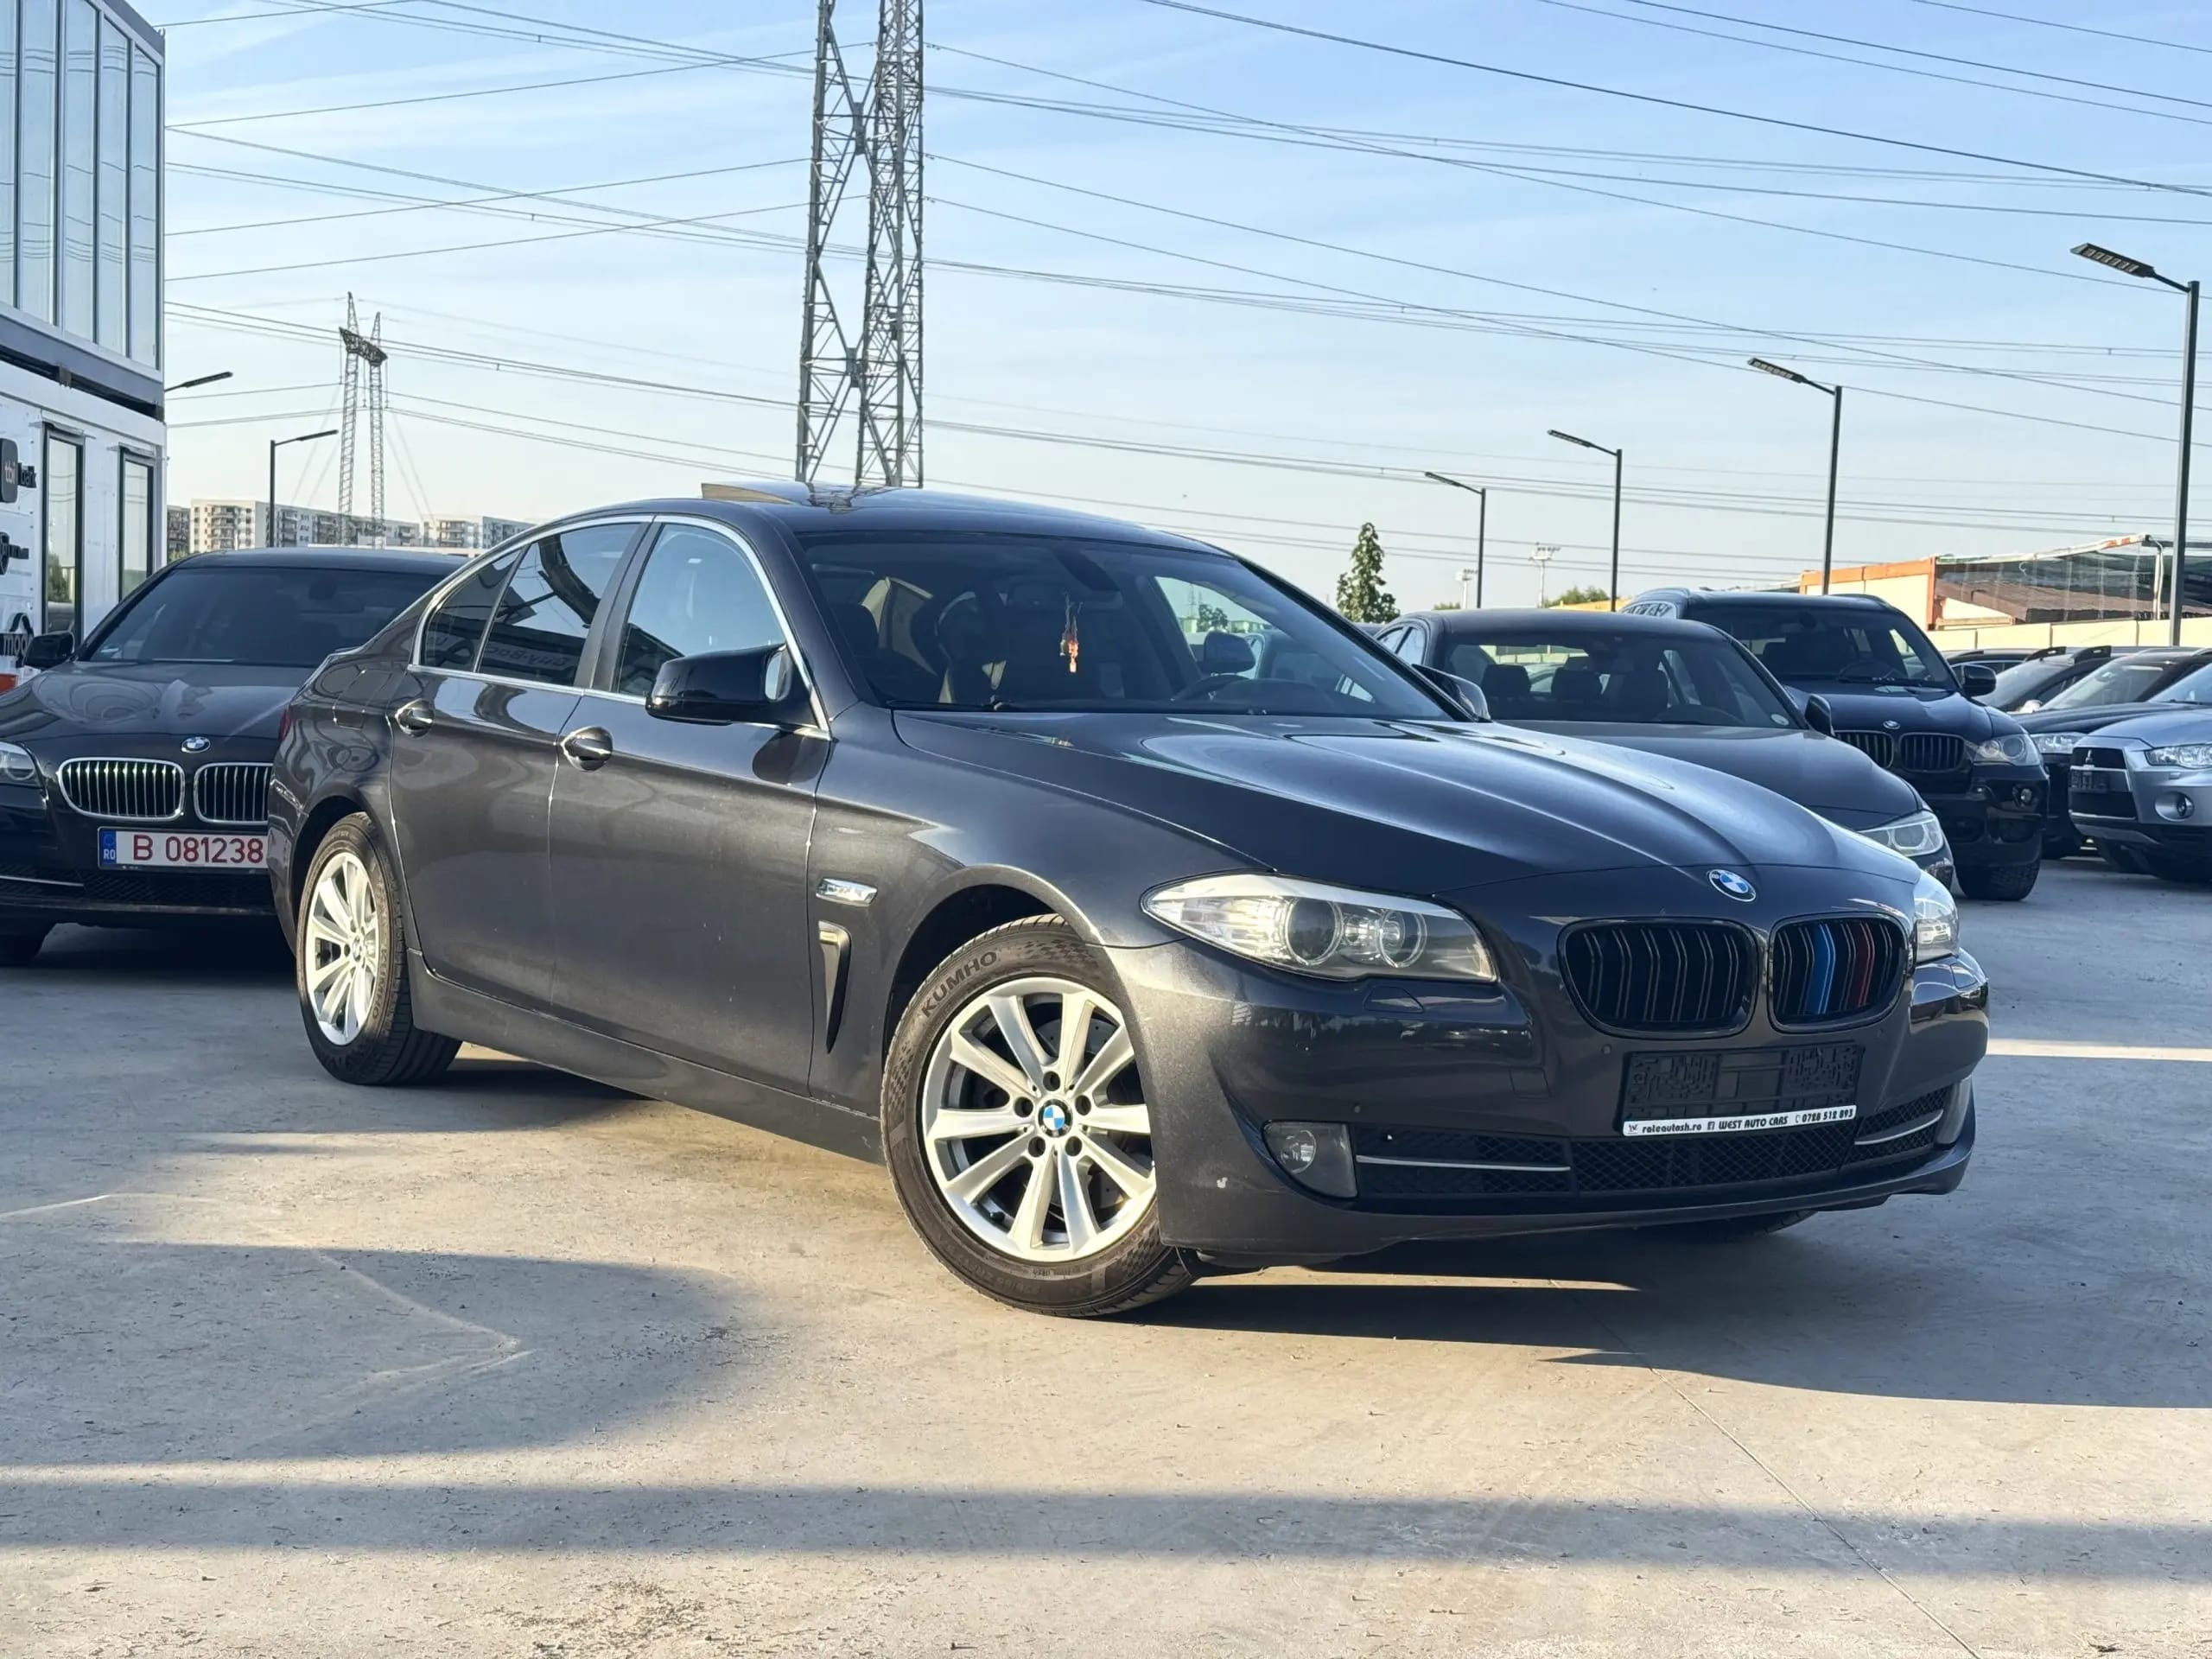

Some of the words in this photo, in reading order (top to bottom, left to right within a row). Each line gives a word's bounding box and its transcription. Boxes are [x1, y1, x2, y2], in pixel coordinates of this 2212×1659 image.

[103, 849, 116, 861] RO
[133, 834, 154, 861] B
[165, 836, 264, 864] 081238
[921, 951, 998, 1018] KUMHO
[1719, 1120, 1743, 1130] WEST
[1745, 1118, 1767, 1128] AUTO
[1769, 1116, 1789, 1126] CARS
